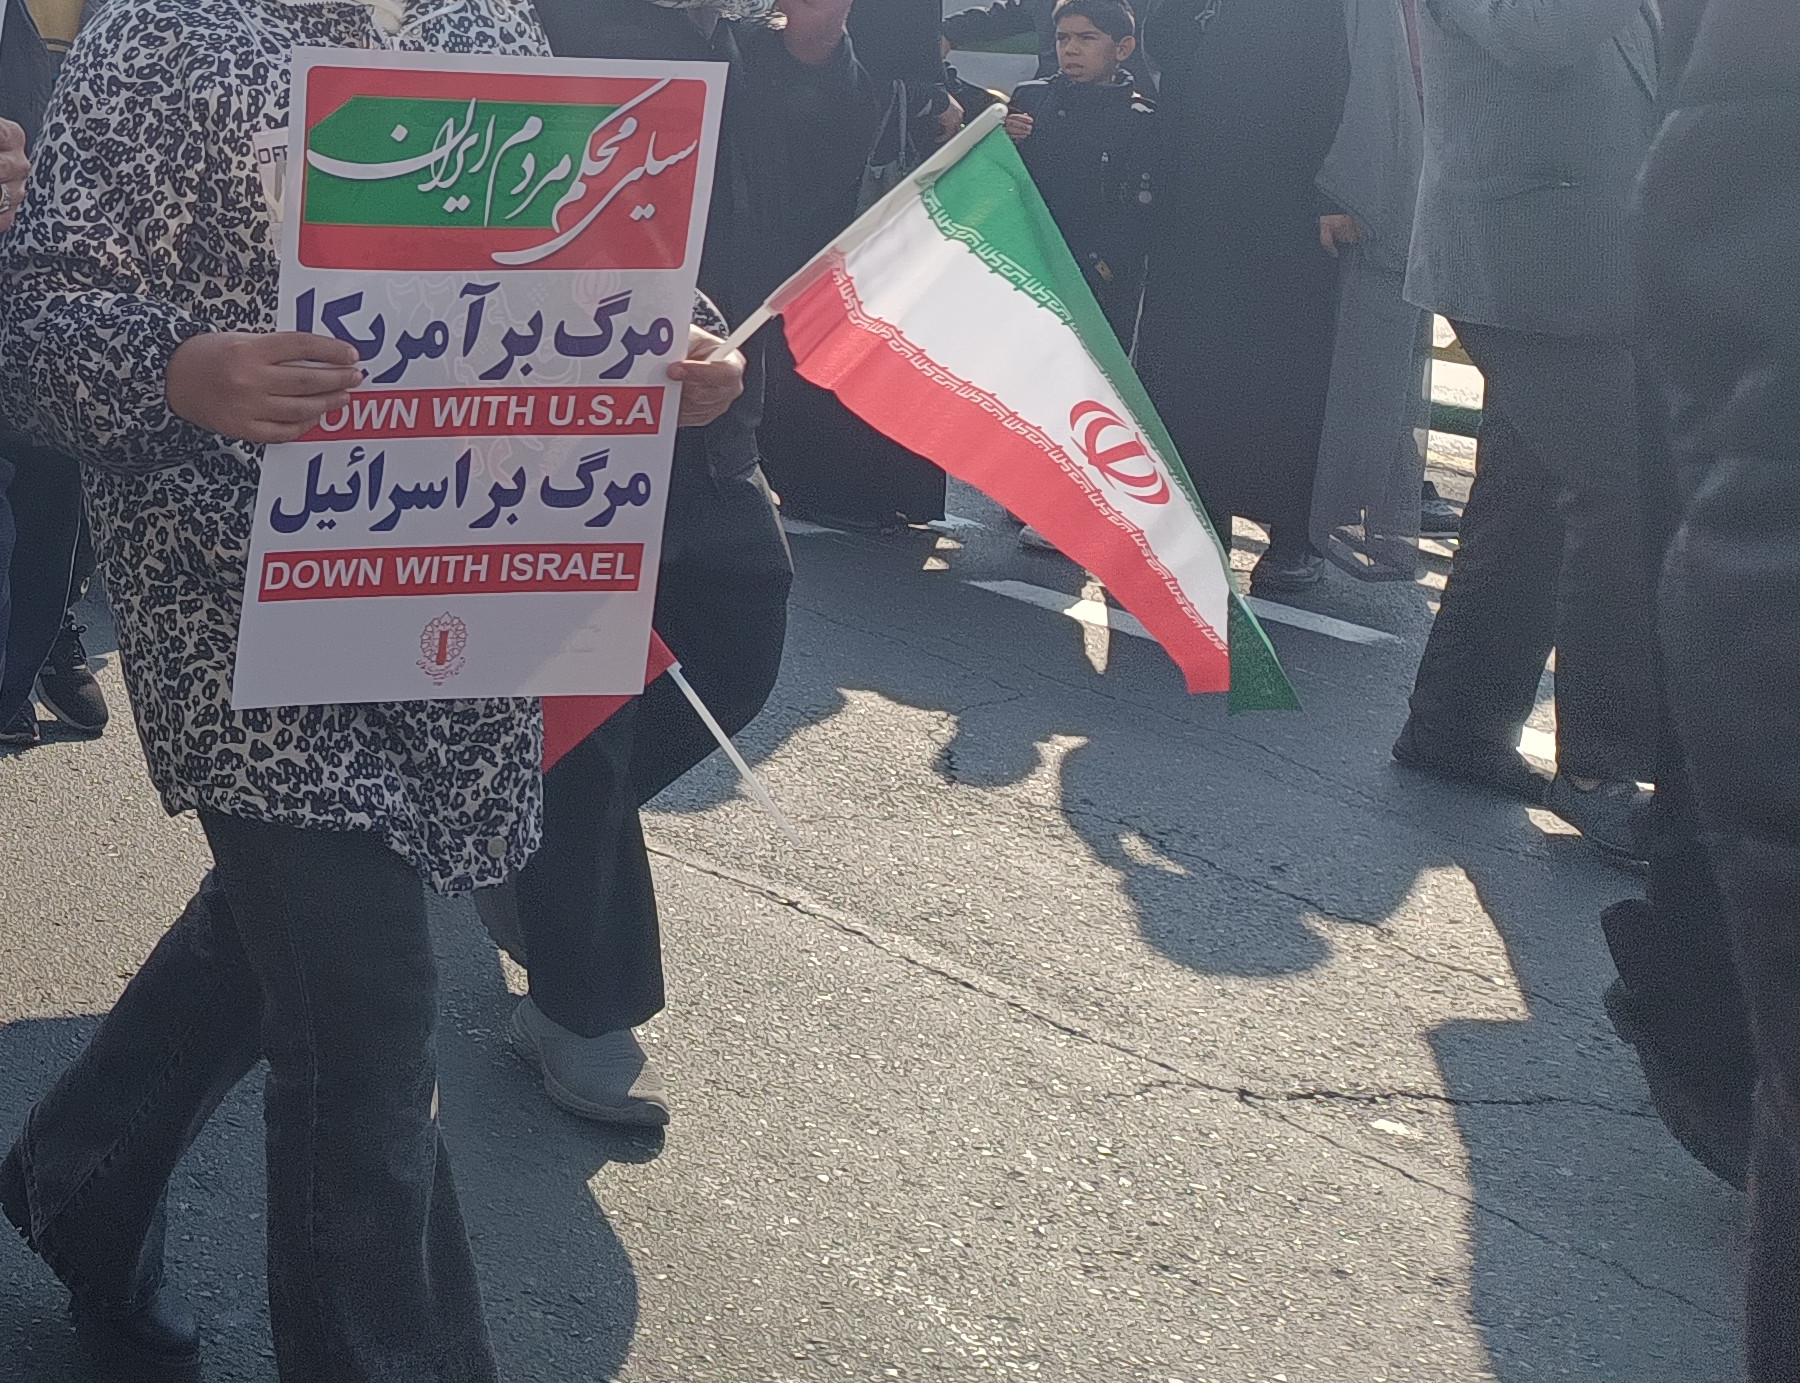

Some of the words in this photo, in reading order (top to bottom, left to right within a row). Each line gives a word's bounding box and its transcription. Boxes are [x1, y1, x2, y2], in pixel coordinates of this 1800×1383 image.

[479, 309, 544, 382] بر
[553, 288, 676, 380] مرگ
[319, 397, 419, 432] OWN
[432, 395, 534, 428] WITH
[548, 394, 656, 427] U.S.A
[269, 445, 472, 534] اسرائیل
[468, 466, 528, 529] بر
[540, 447, 652, 528] مرگ
[263, 557, 384, 592] DOWN
[394, 554, 490, 587] WITH
[499, 552, 636, 584] ISRAEL
